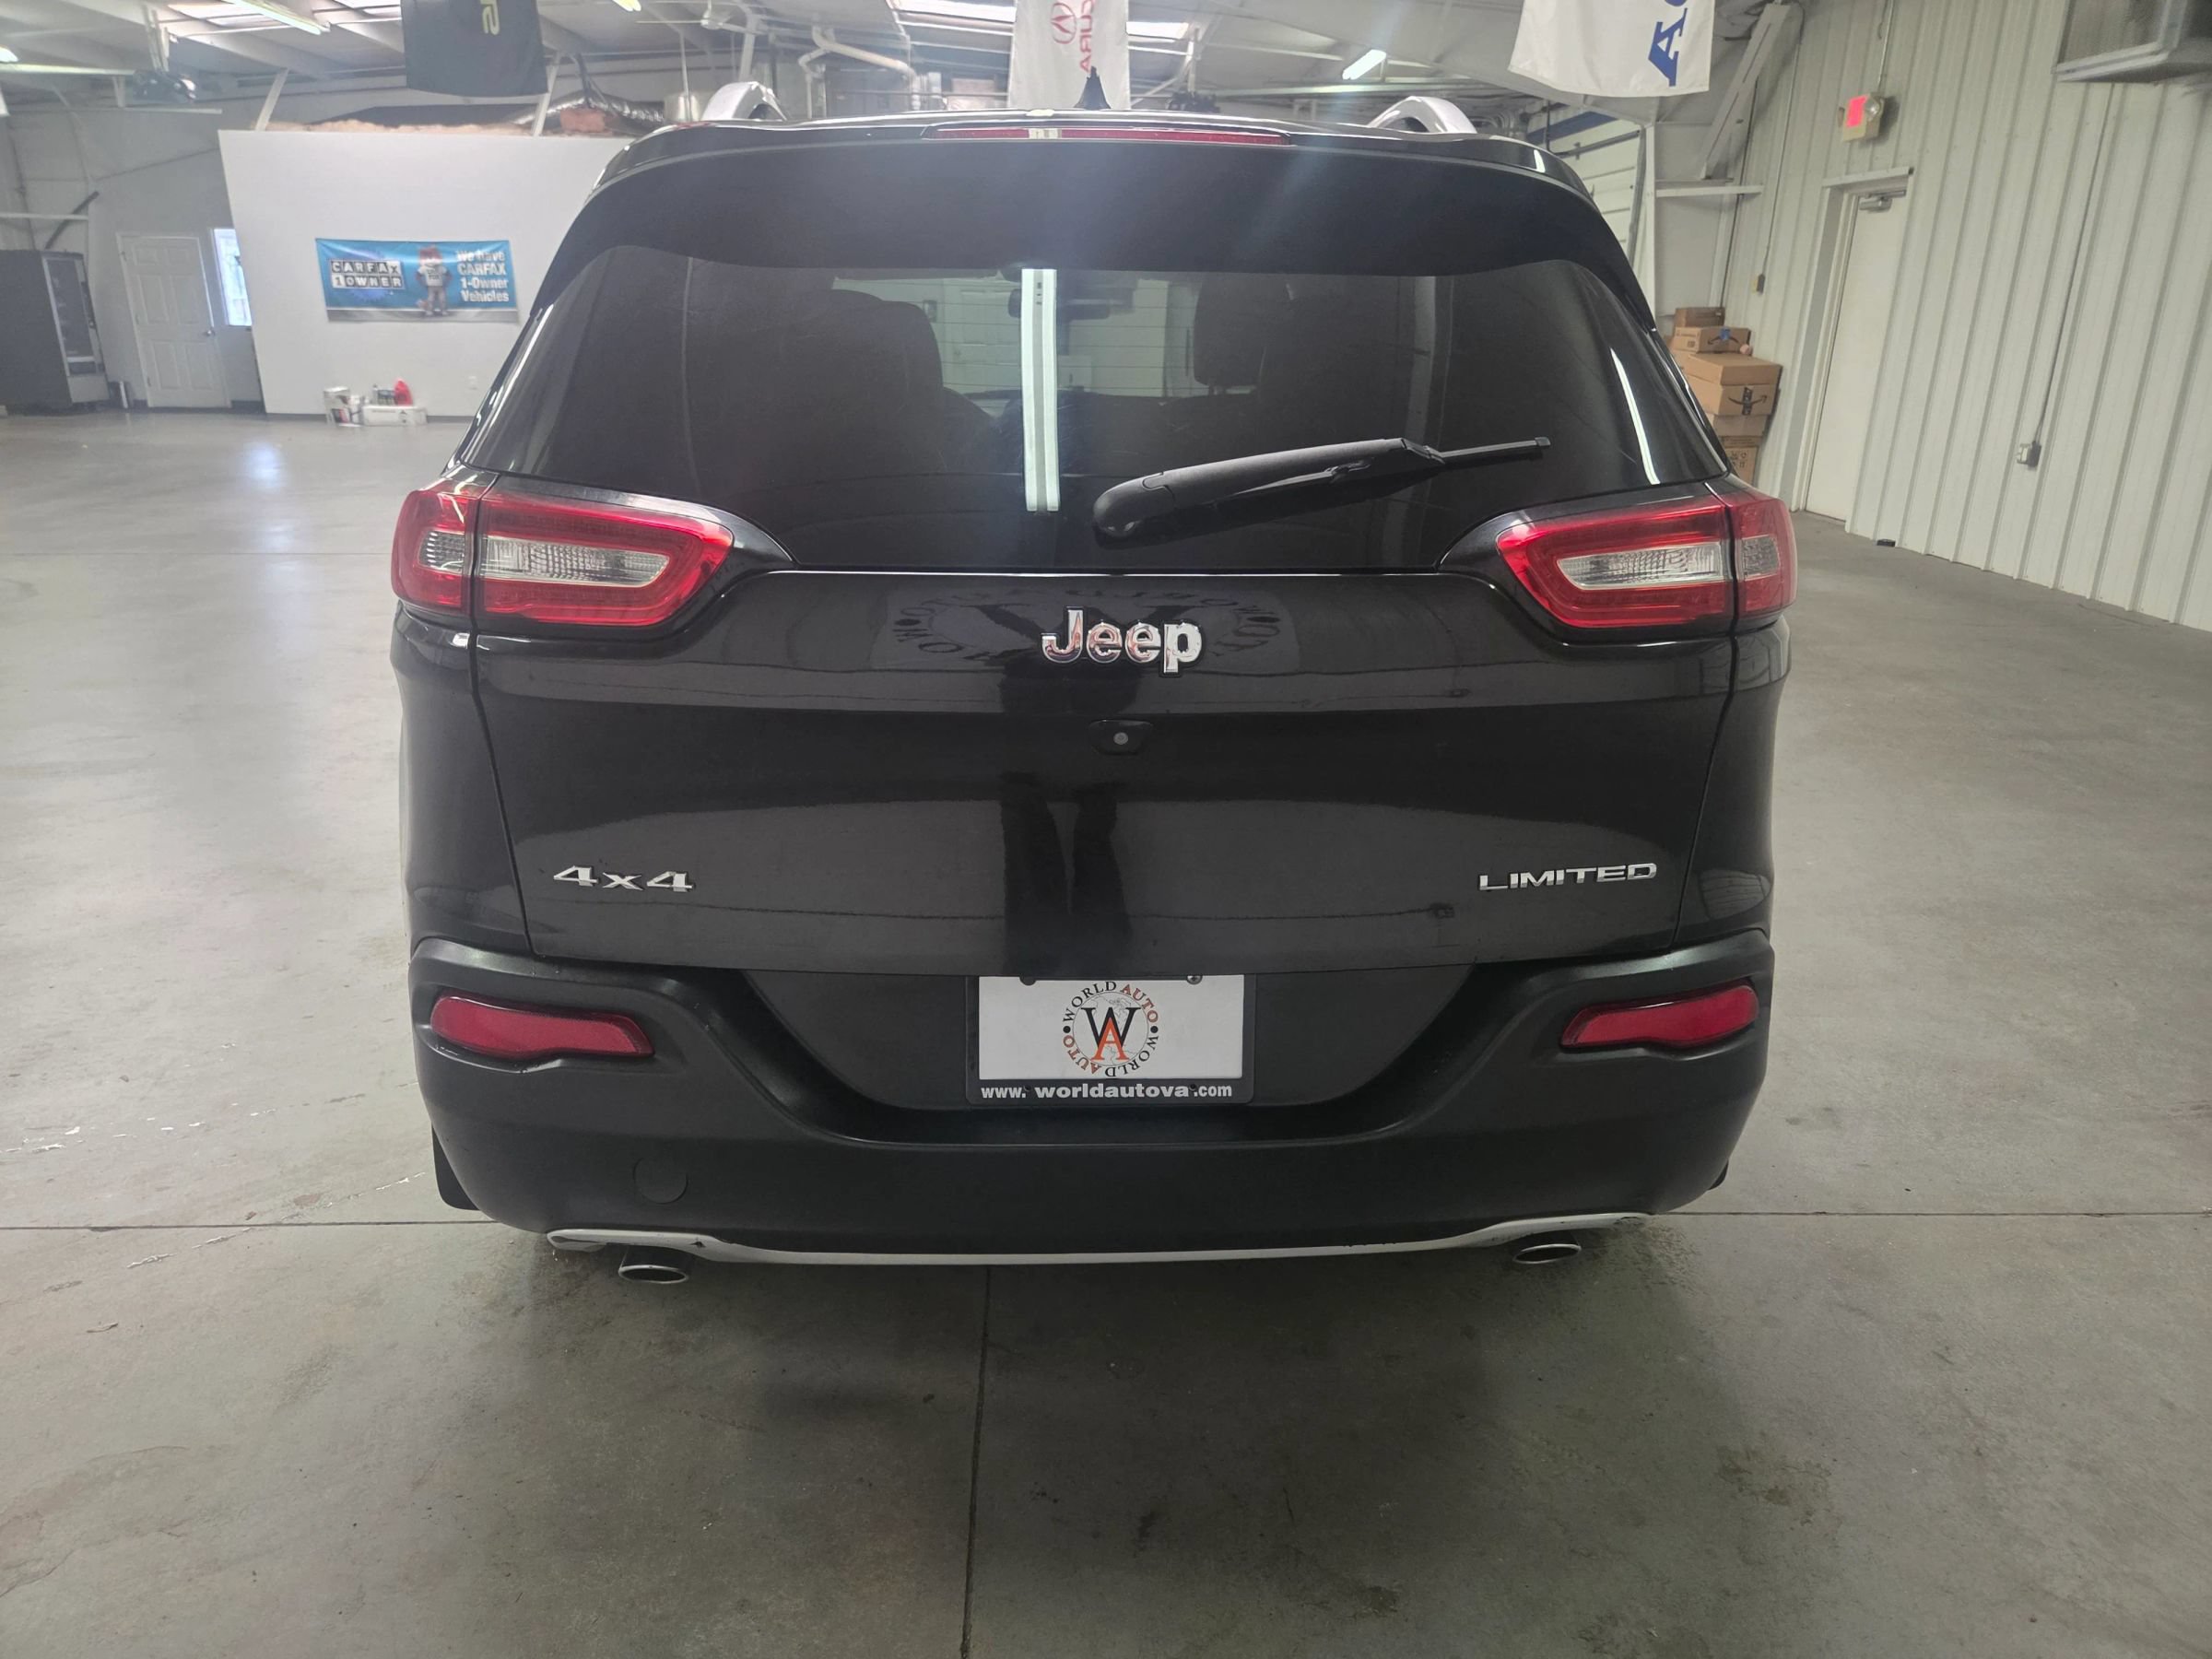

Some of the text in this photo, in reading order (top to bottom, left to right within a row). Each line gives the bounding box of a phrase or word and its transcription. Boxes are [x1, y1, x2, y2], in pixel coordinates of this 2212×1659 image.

[332, 262, 399, 274] CARFAX
[457, 263, 506, 276] CARFAX
[461, 276, 509, 289] 1-Owner
[461, 289, 510, 302] Vehicles
[1041, 606, 1203, 674] Jeep
[553, 865, 693, 892] 4x4
[1479, 862, 1657, 891] LIMITED
[1062, 981, 1159, 1024] WORLD AUTO
[1063, 1034, 1159, 1077] WORLD AUTO
